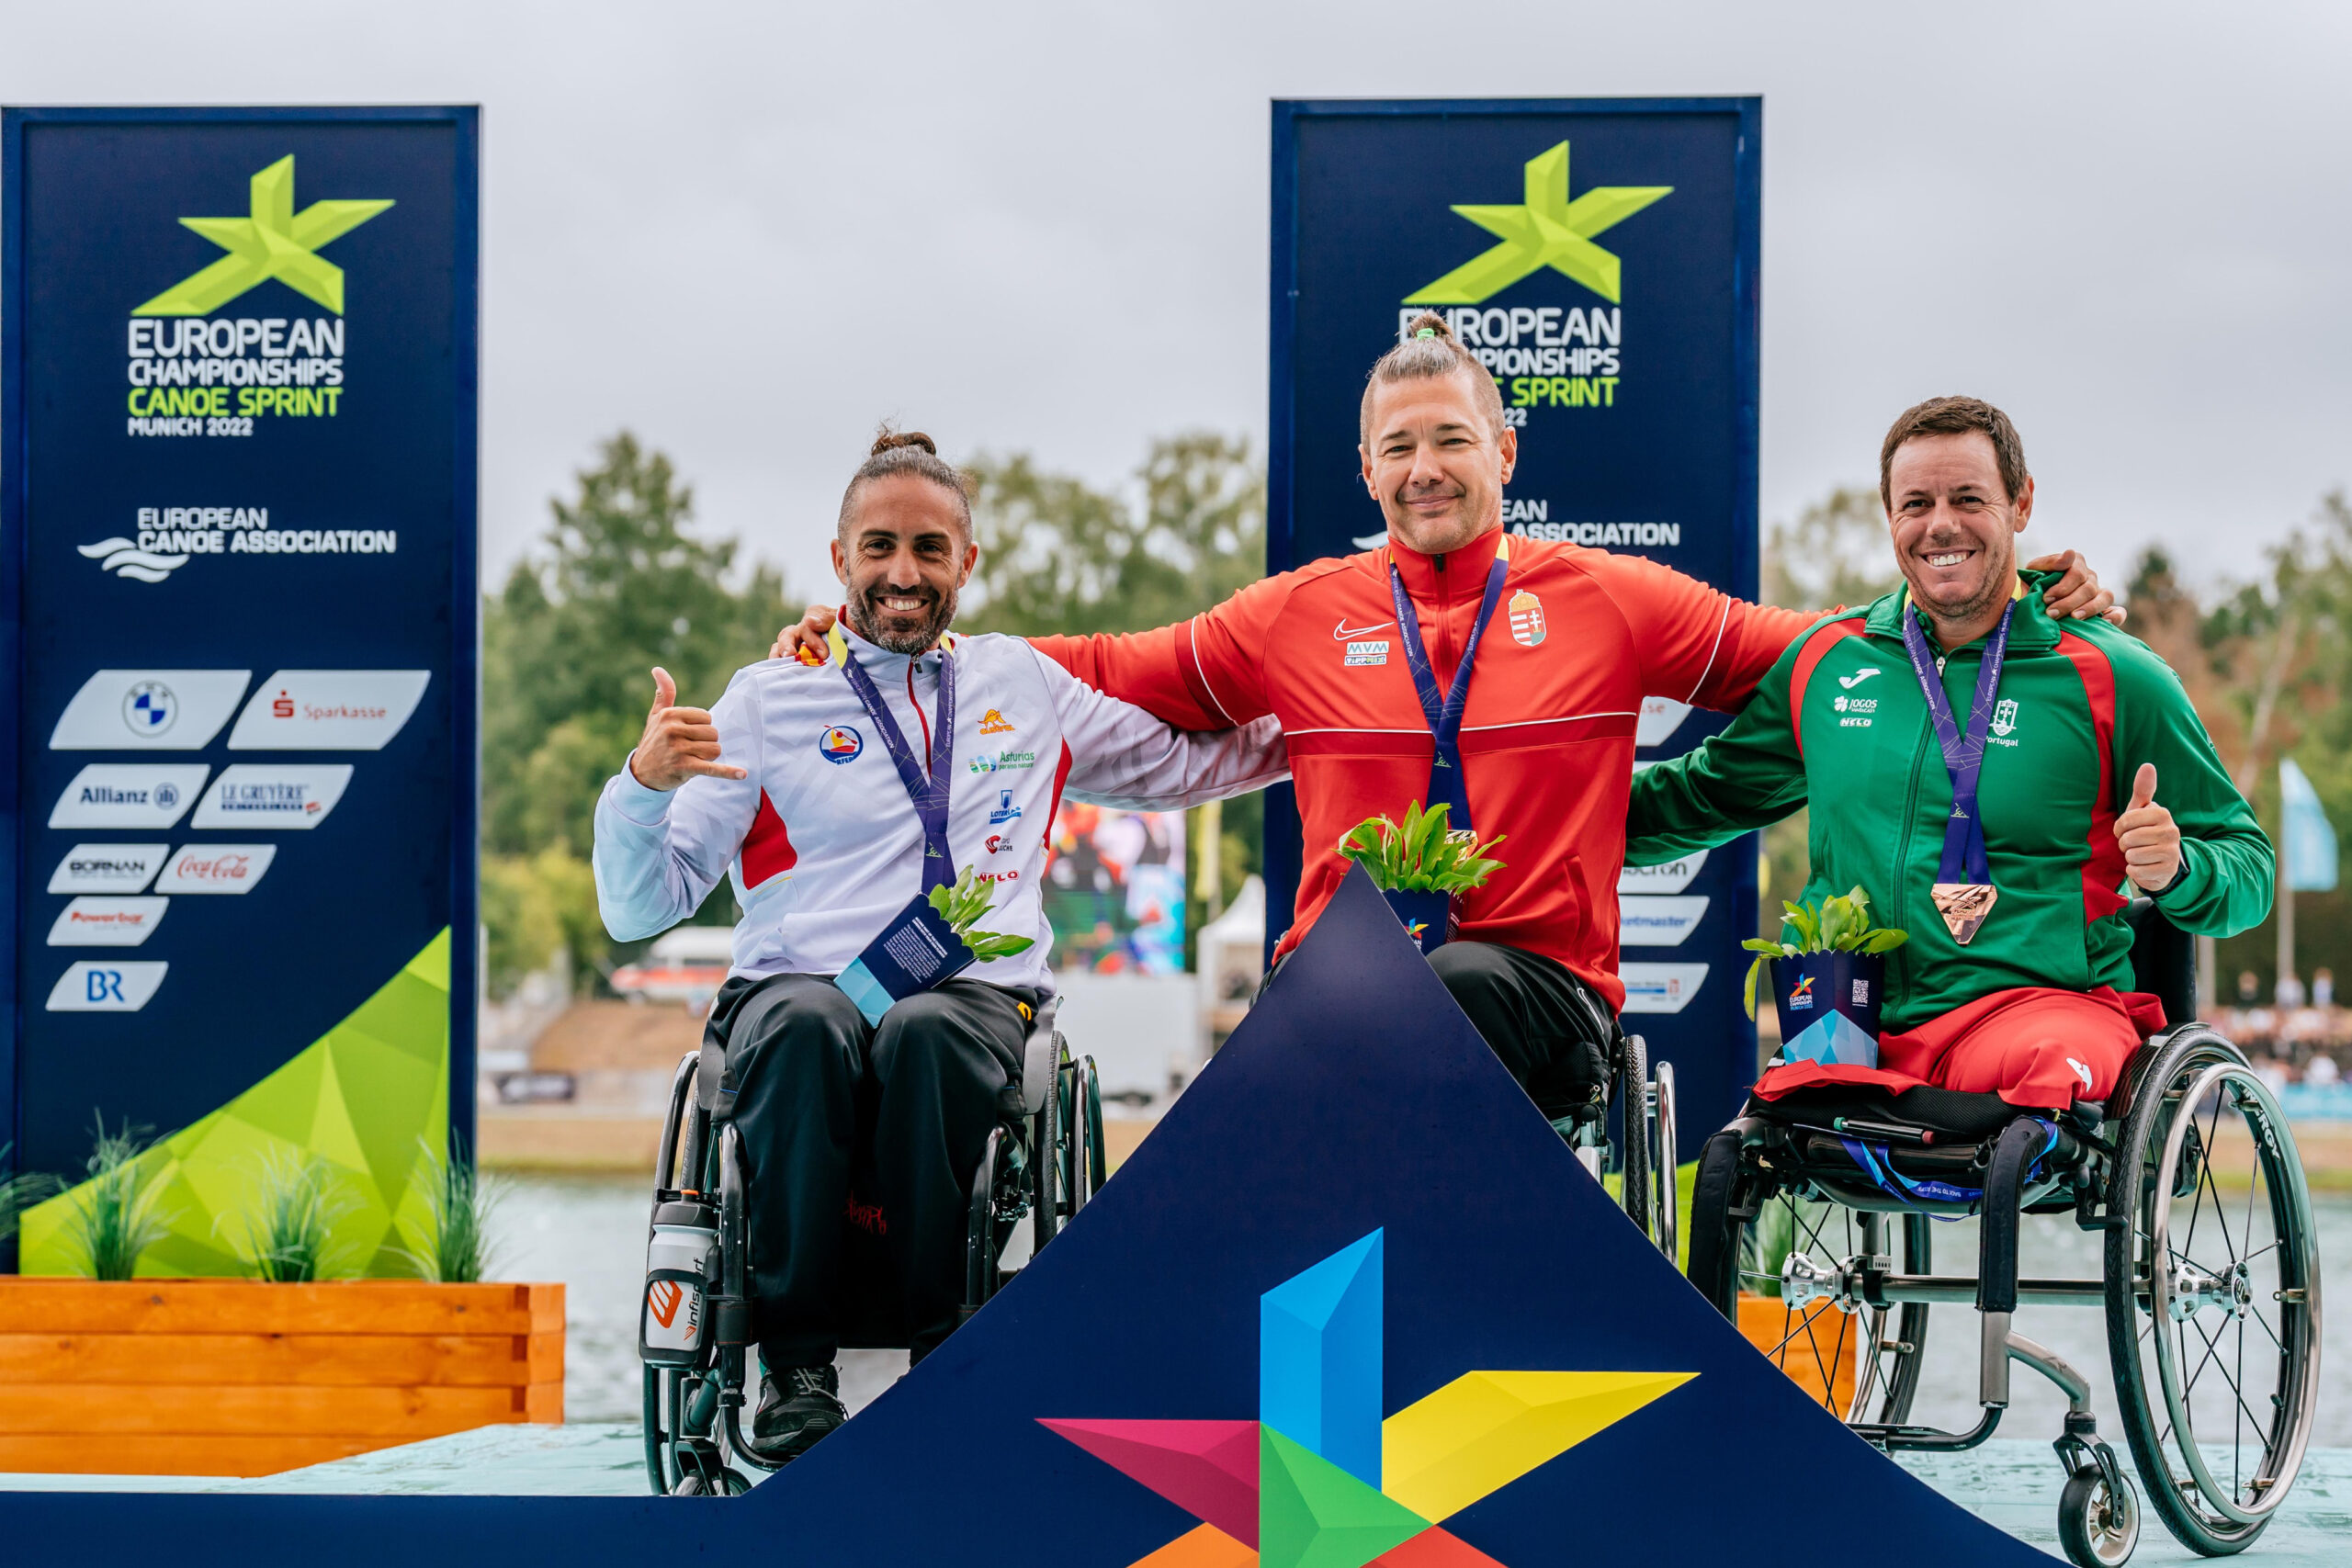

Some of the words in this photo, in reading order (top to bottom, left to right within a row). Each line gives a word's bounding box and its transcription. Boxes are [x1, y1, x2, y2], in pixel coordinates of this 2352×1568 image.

[128, 318, 345, 357] EUROPEAN
[128, 358, 344, 387] CHAMPIONSHIPS
[1470, 347, 1620, 377] PIONSHIPS
[128, 387, 231, 417] CANOE
[237, 387, 344, 417] SPRINT
[1511, 377, 1620, 408] SPRINT
[128, 417, 202, 436] MUNICH
[206, 417, 254, 436] 2022
[138, 507, 268, 531] EUROPEAN
[138, 530, 225, 553] CANOE
[230, 530, 396, 553] ASSOCIATION
[1511, 523, 1679, 546] ASSOCIATION
[1348, 643, 1388, 653] MVM
[303, 704, 388, 719] Sparkasse
[1849, 698, 1878, 710] JOGOS
[1840, 717, 1872, 728] NELO
[1000, 750, 1035, 762] Asturias
[79, 786, 148, 805] Allianz
[86, 970, 125, 1002] BR
[1789, 995, 1813, 1003] EUROPEAN
